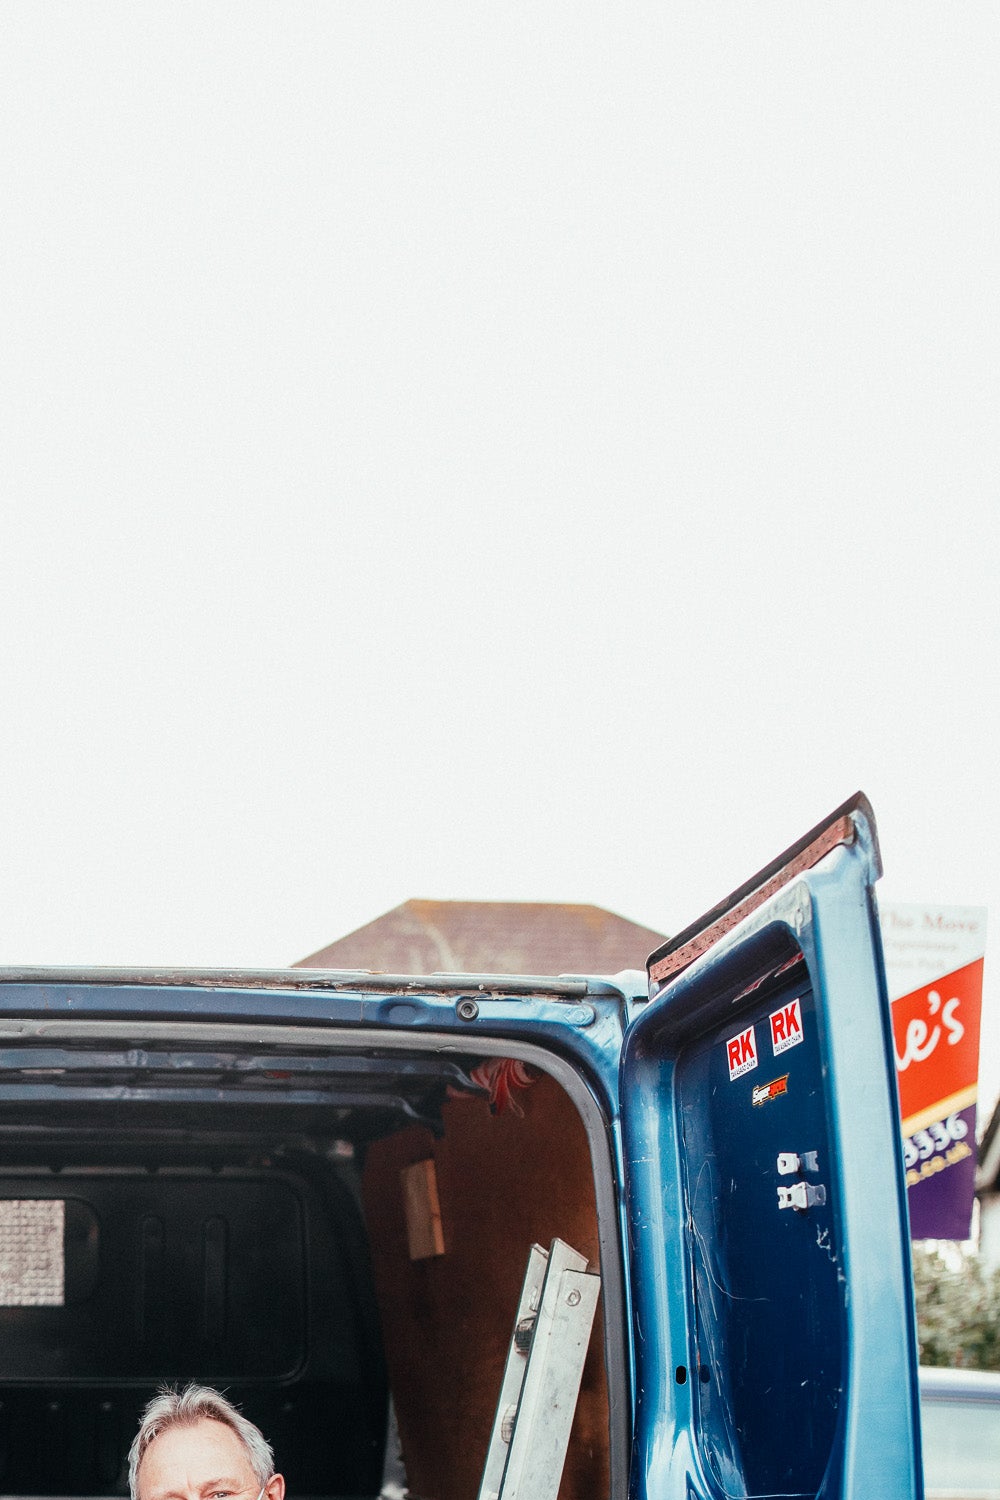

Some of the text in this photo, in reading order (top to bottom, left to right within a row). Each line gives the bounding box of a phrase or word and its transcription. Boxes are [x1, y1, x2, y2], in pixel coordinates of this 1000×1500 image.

[771, 1003, 800, 1045] RK
[893, 990, 965, 1072] e's
[728, 1030, 755, 1071] RK
